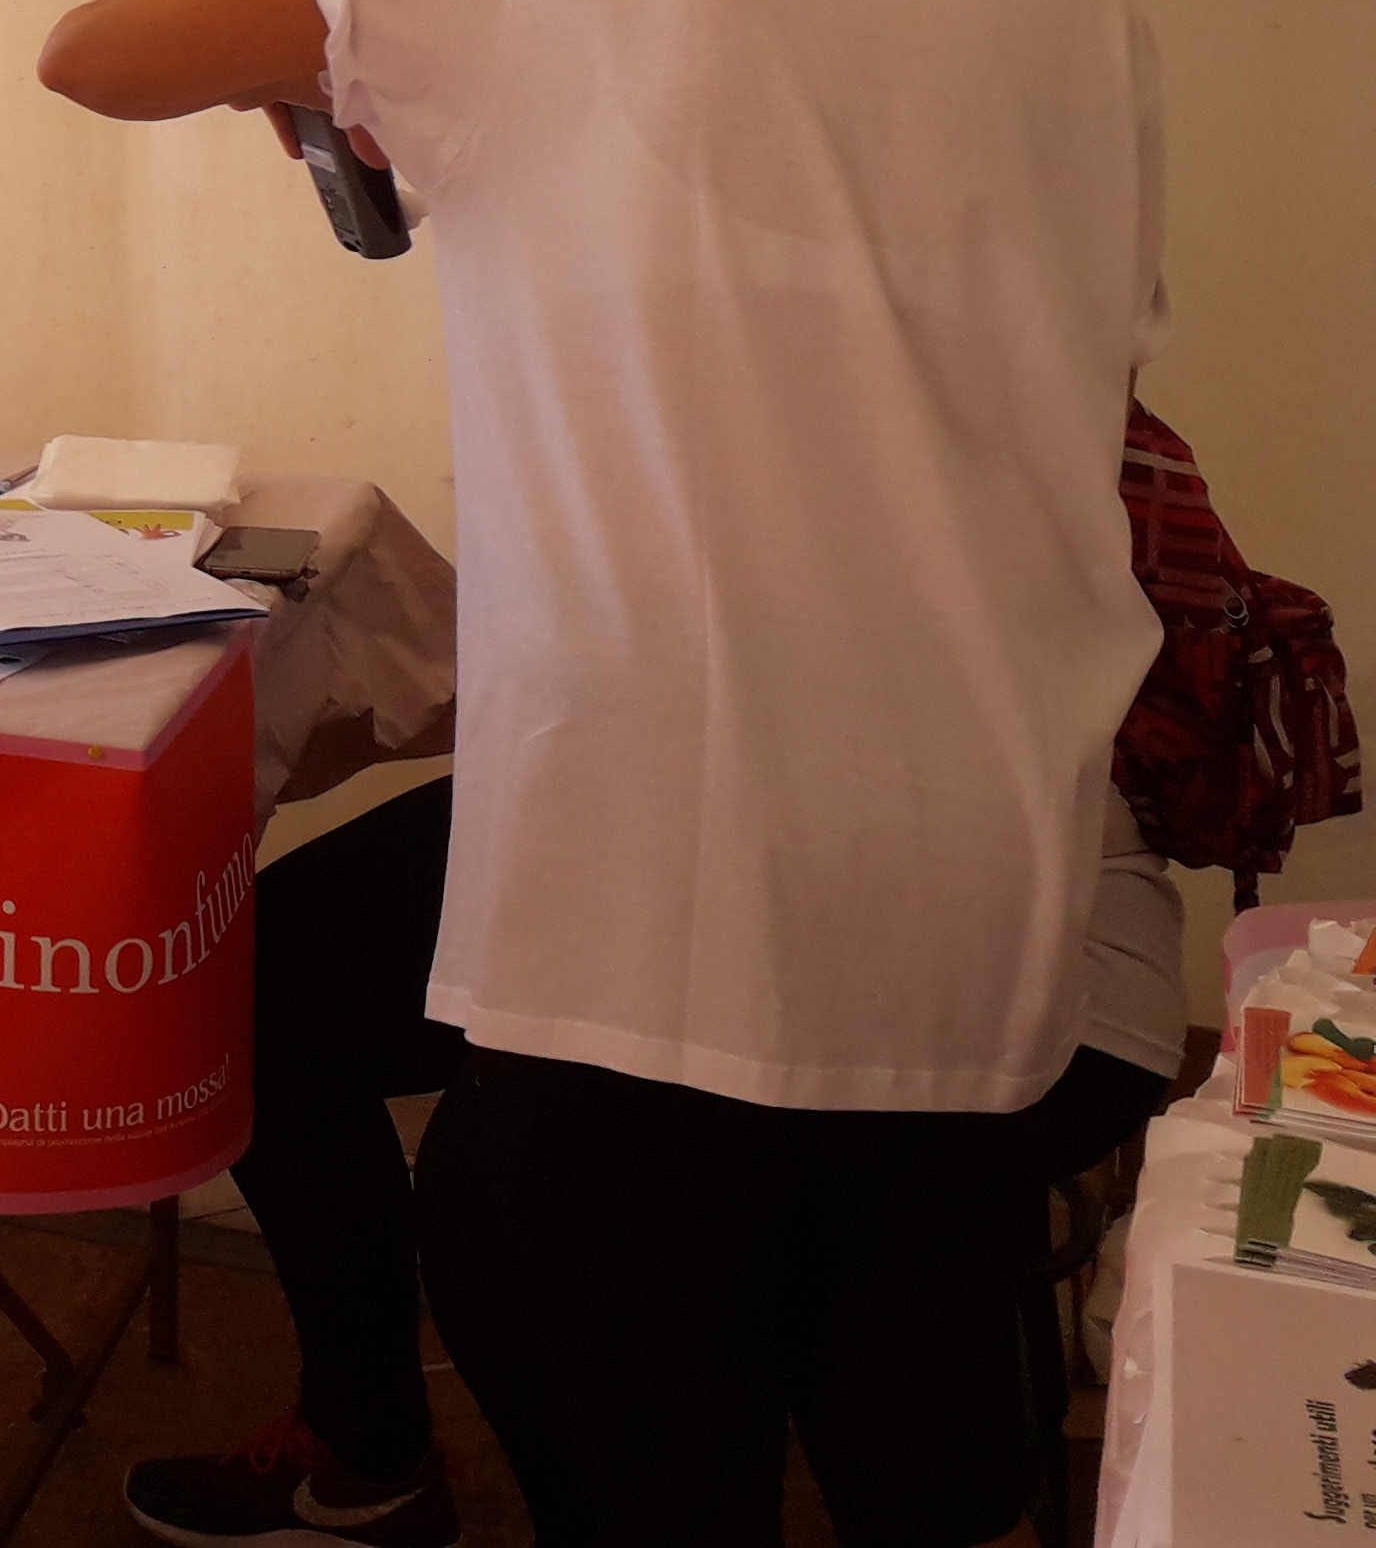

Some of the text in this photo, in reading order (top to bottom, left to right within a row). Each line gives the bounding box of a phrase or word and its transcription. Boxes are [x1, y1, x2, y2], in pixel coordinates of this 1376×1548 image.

[82, 1102, 146, 1131] una
[156, 1053, 231, 1121] mossa!
[1303, 1398, 1350, 1524] Suggerimenti utili
